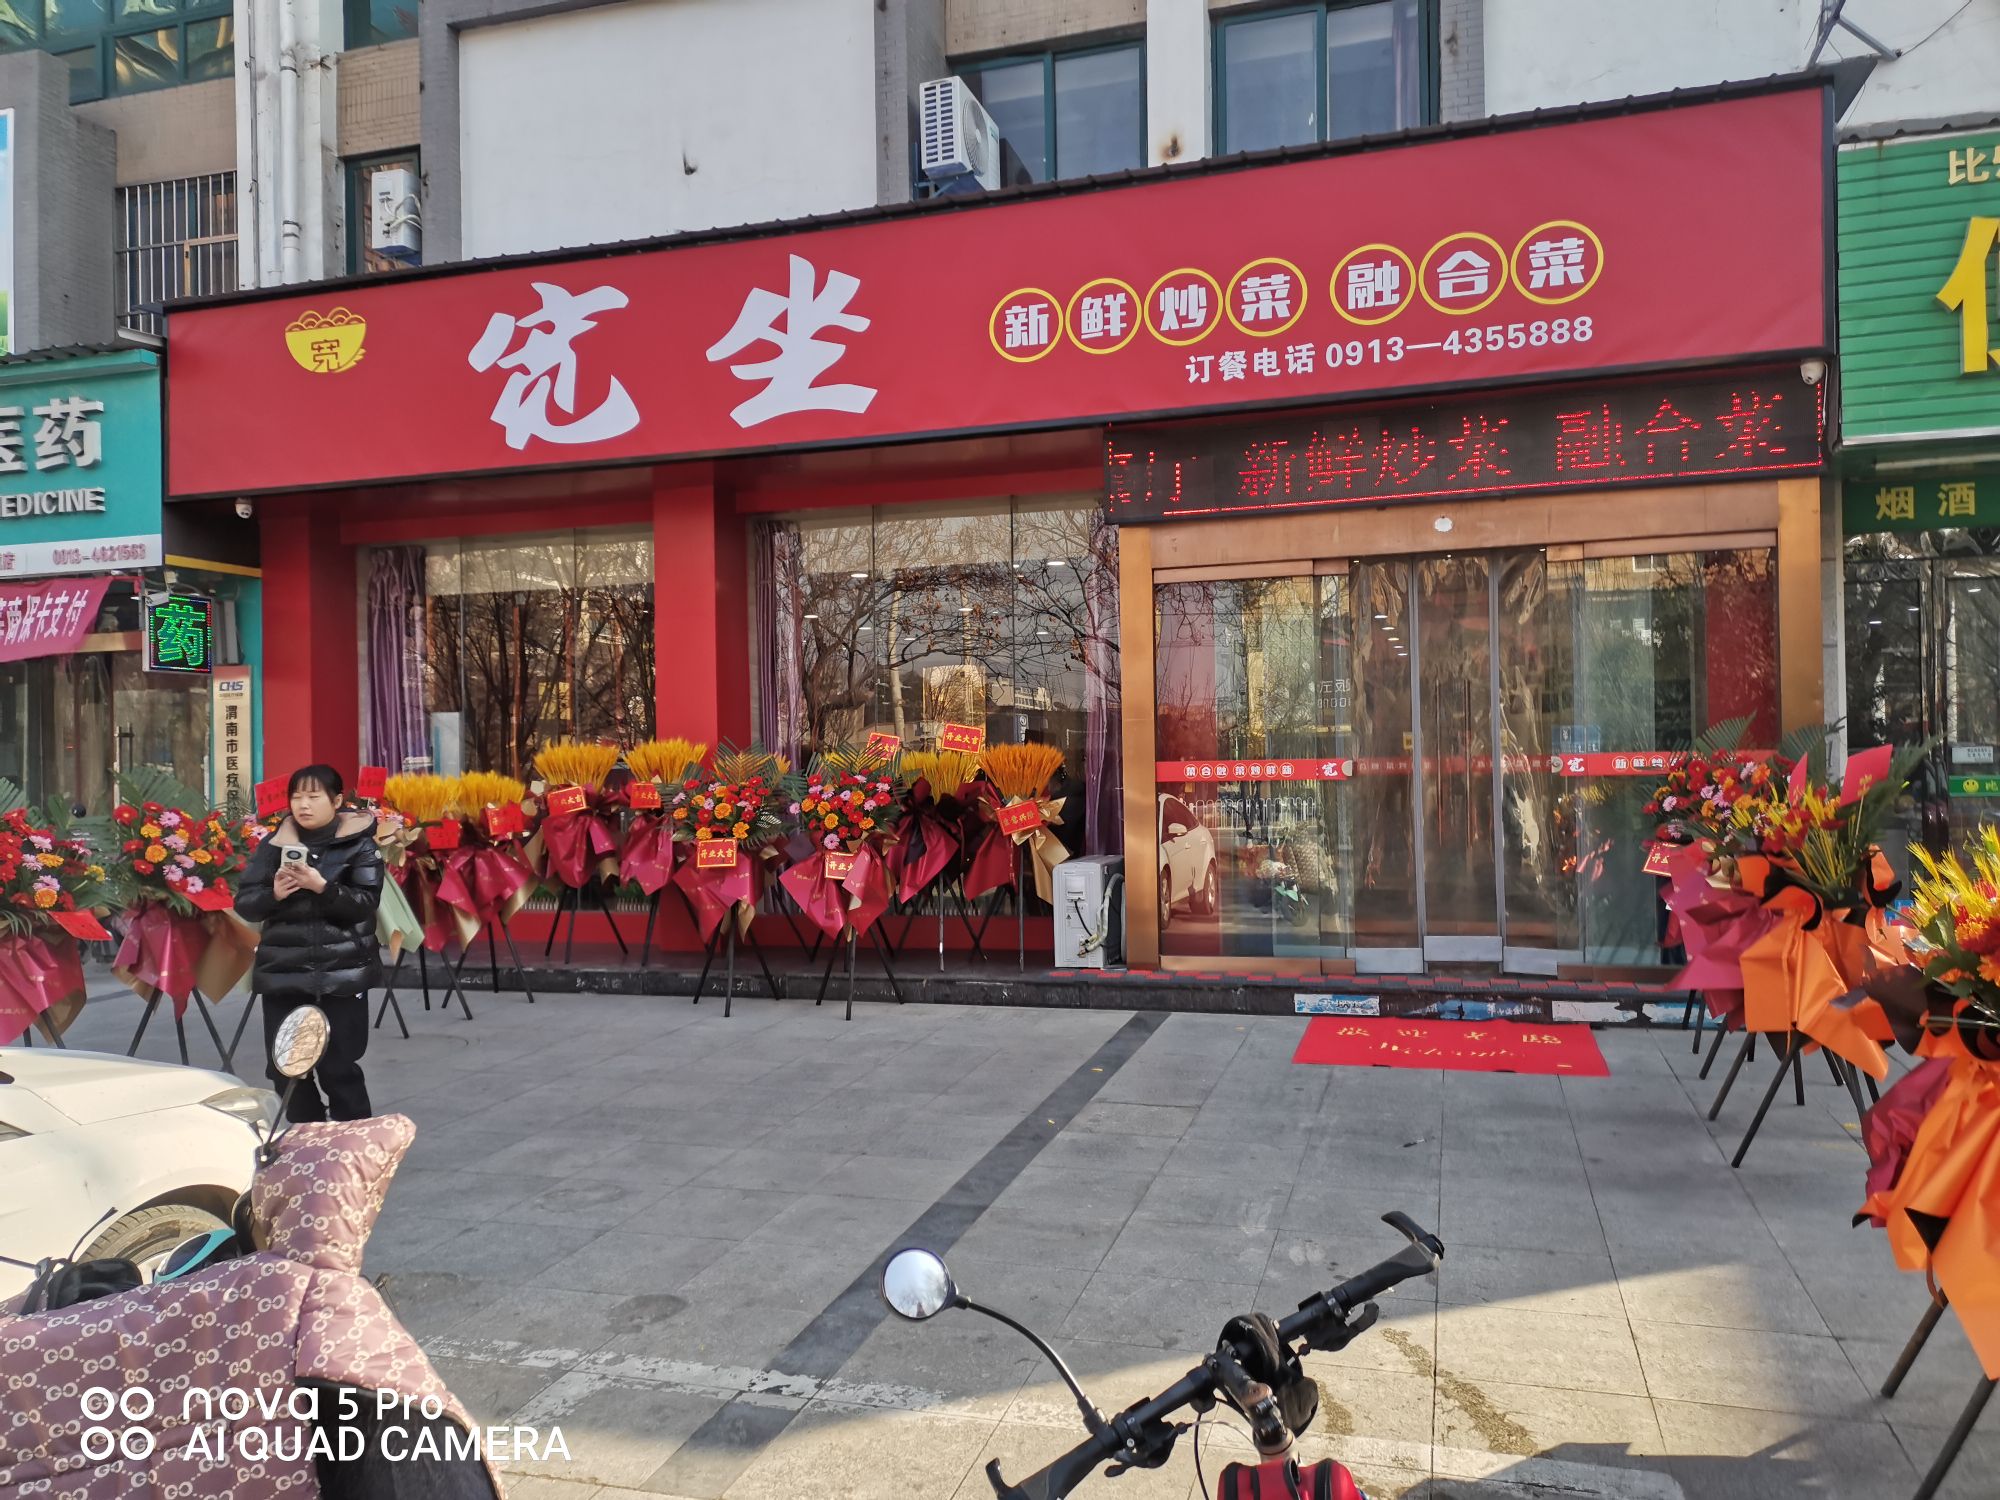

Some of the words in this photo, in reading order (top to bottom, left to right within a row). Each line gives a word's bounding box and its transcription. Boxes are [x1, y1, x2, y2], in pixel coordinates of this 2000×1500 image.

[1948, 145, 2000, 185] 比
[1003, 272, 1292, 349] 新鲜炒菜
[1345, 235, 1586, 312] 融合菜
[1184, 341, 1316, 385] 订餐电话
[0, 487, 106, 517] EDICINE
[0, 551, 15, 571] 店
[156, 603, 206, 666] 药
[945, 731, 979, 746] 开业大吉
[699, 848, 734, 859] 开业大吉
